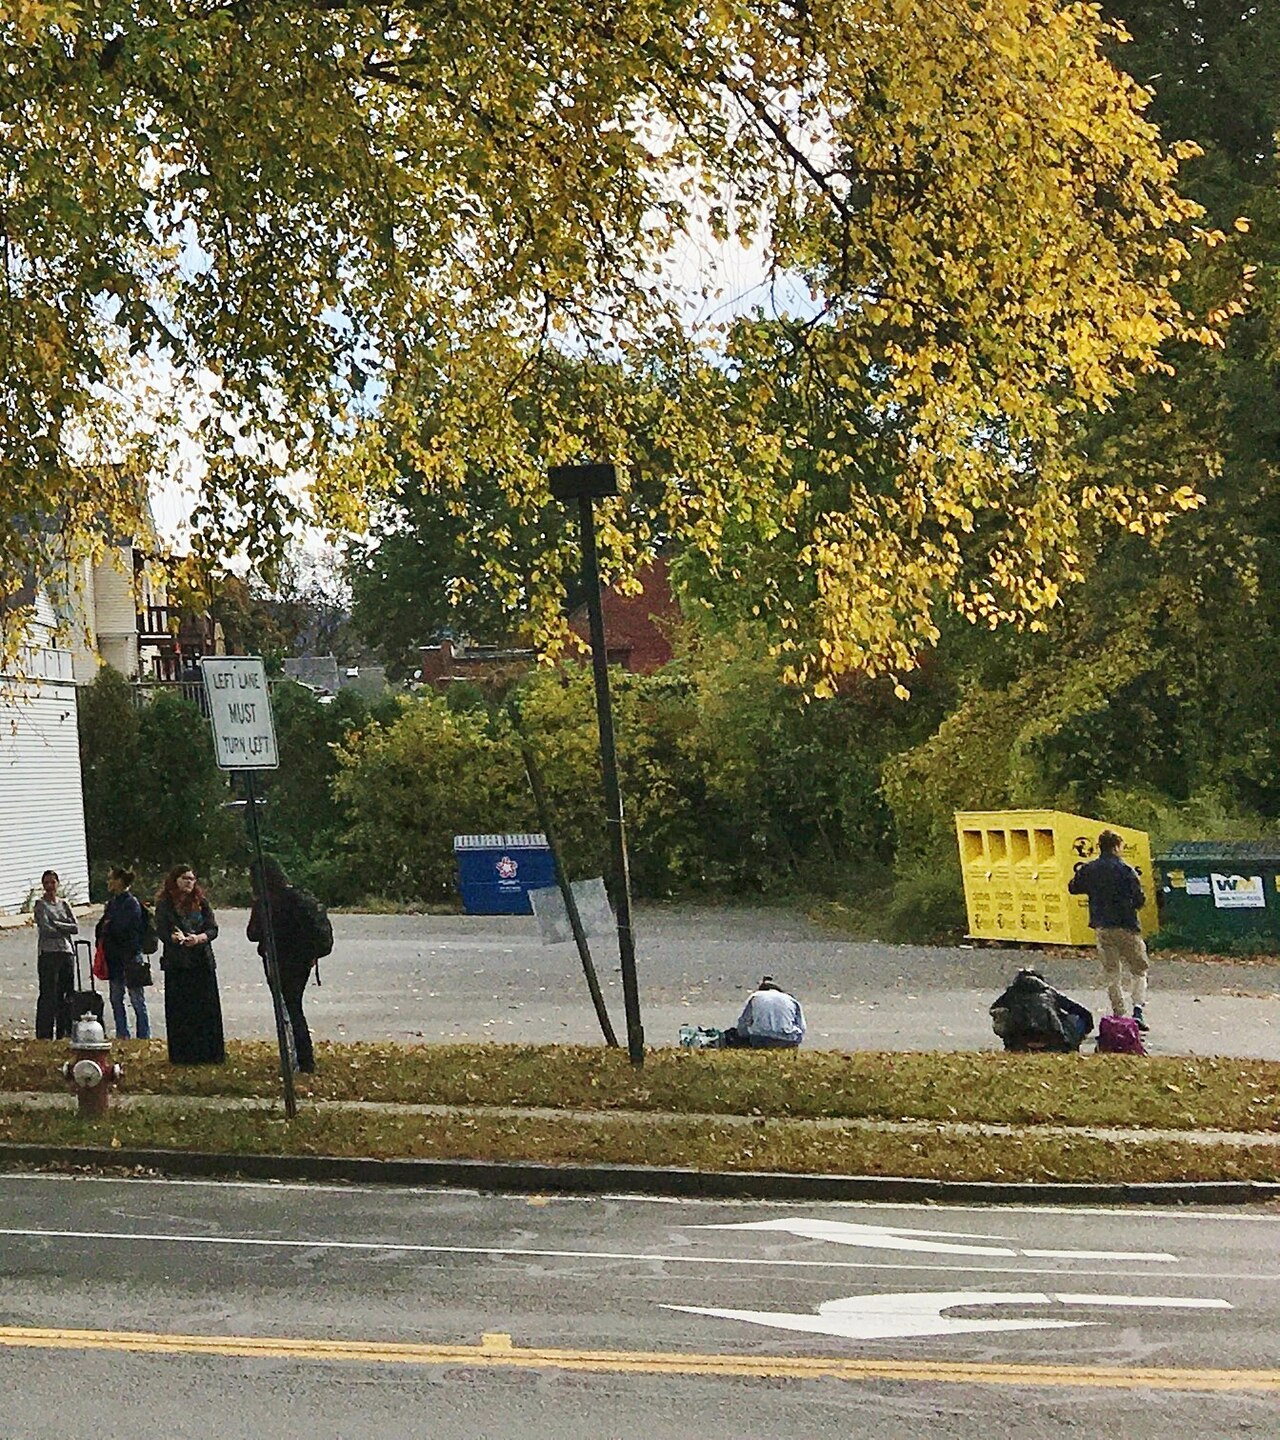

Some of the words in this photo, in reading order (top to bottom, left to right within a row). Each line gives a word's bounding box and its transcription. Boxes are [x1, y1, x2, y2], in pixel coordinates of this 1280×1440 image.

[212, 673, 235, 689] LEFT
[239, 673, 261, 689] LANE
[228, 703, 256, 724] MUST
[222, 735, 246, 754] TURN
[249, 736, 269, 755] LEFT
